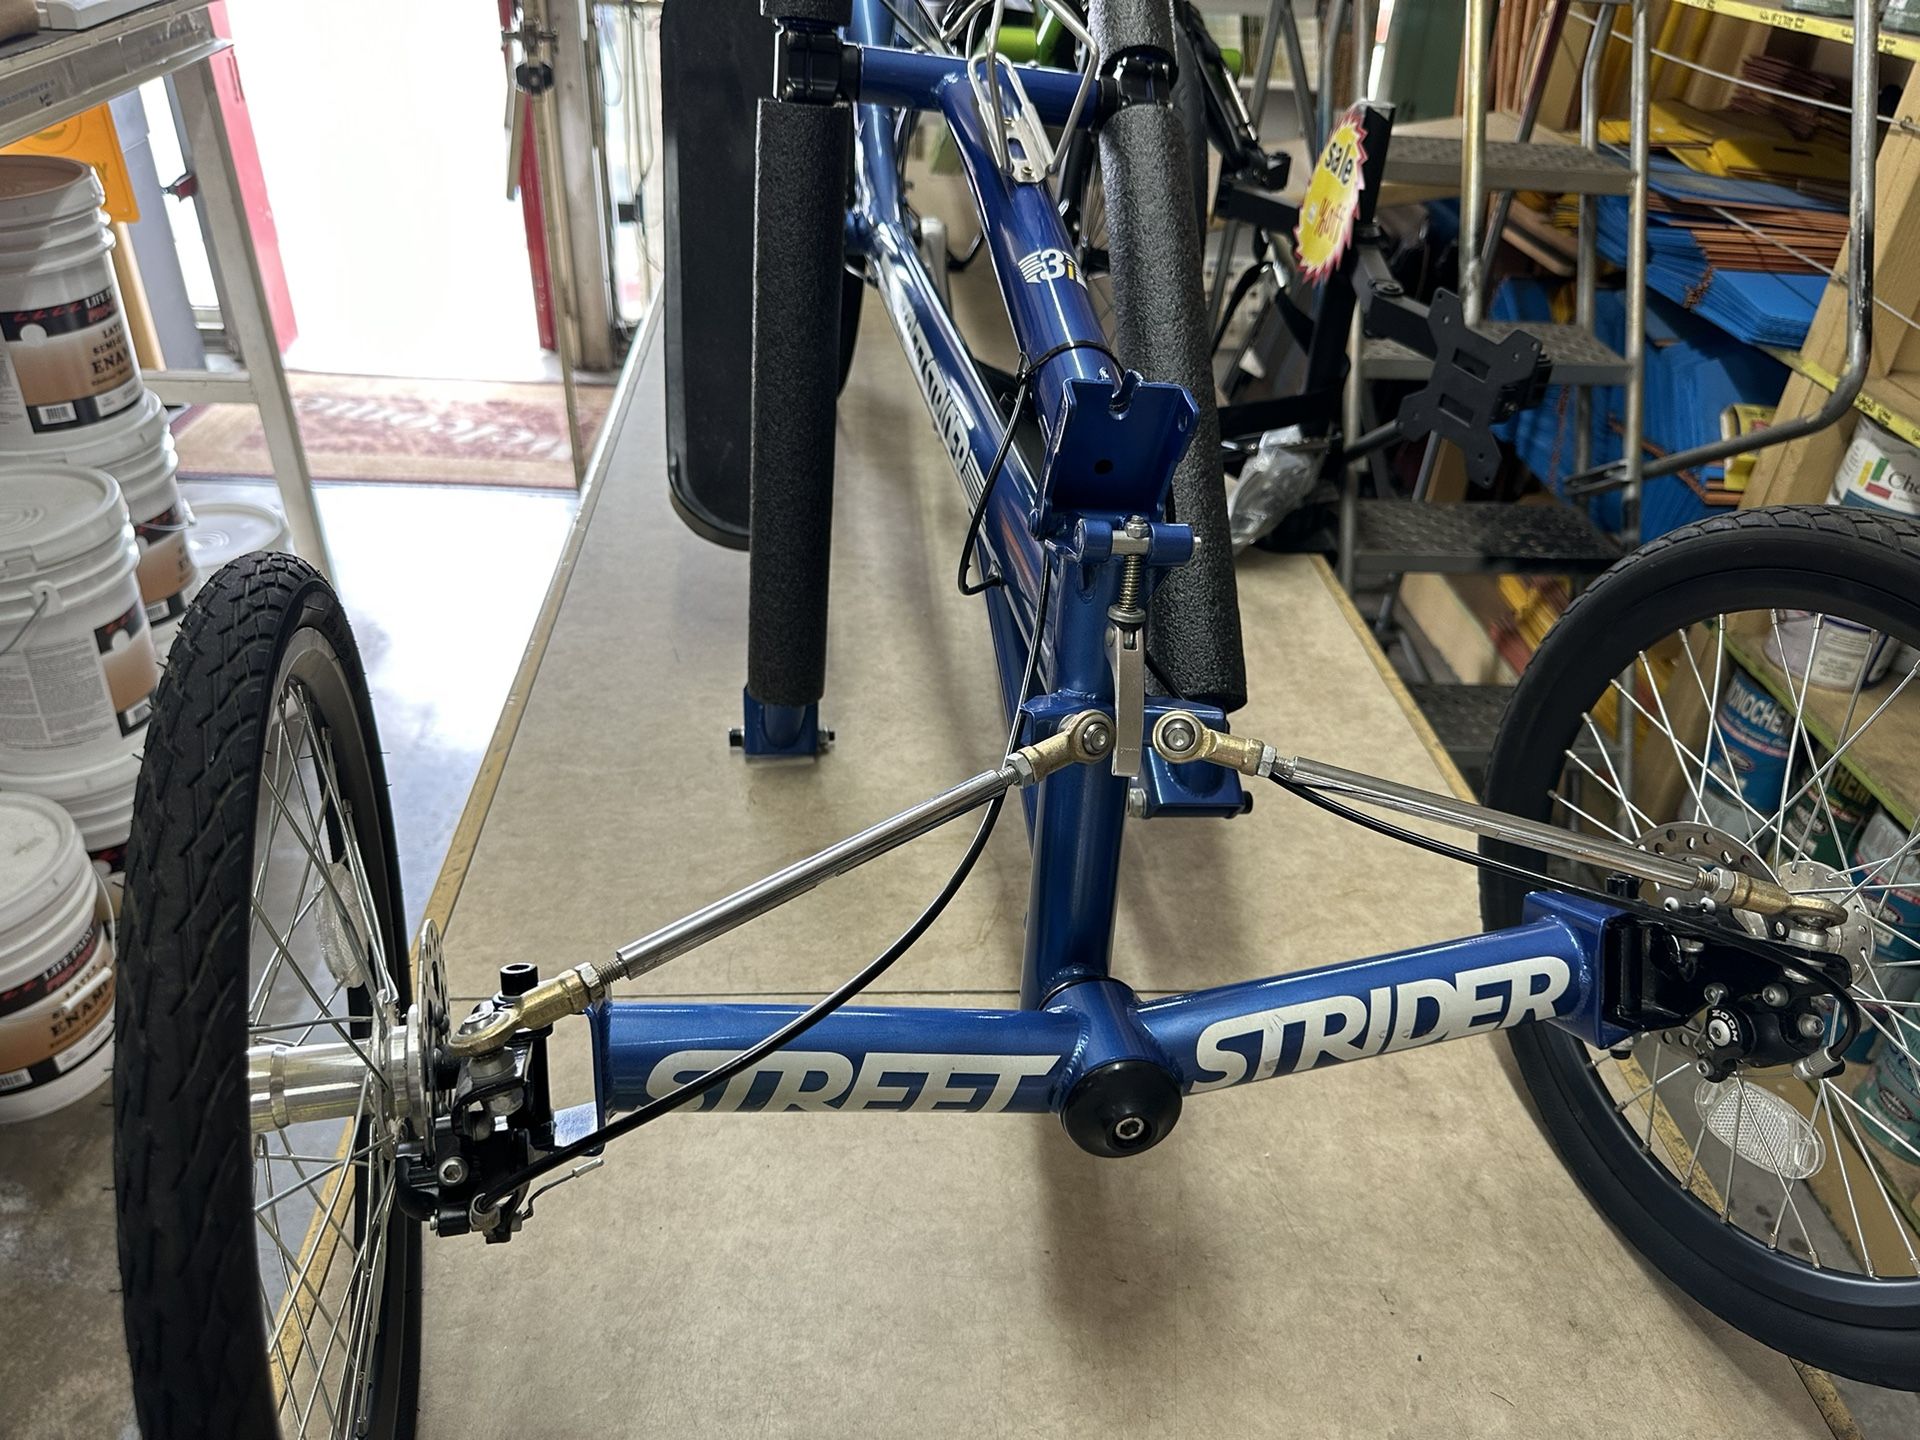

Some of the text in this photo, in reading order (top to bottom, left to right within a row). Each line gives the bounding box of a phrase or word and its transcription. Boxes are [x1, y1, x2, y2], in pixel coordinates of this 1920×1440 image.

[1190, 956, 1571, 1095] STRIDER
[1711, 1009, 1739, 1042] ZOOM
[640, 1049, 1061, 1113] STREET
